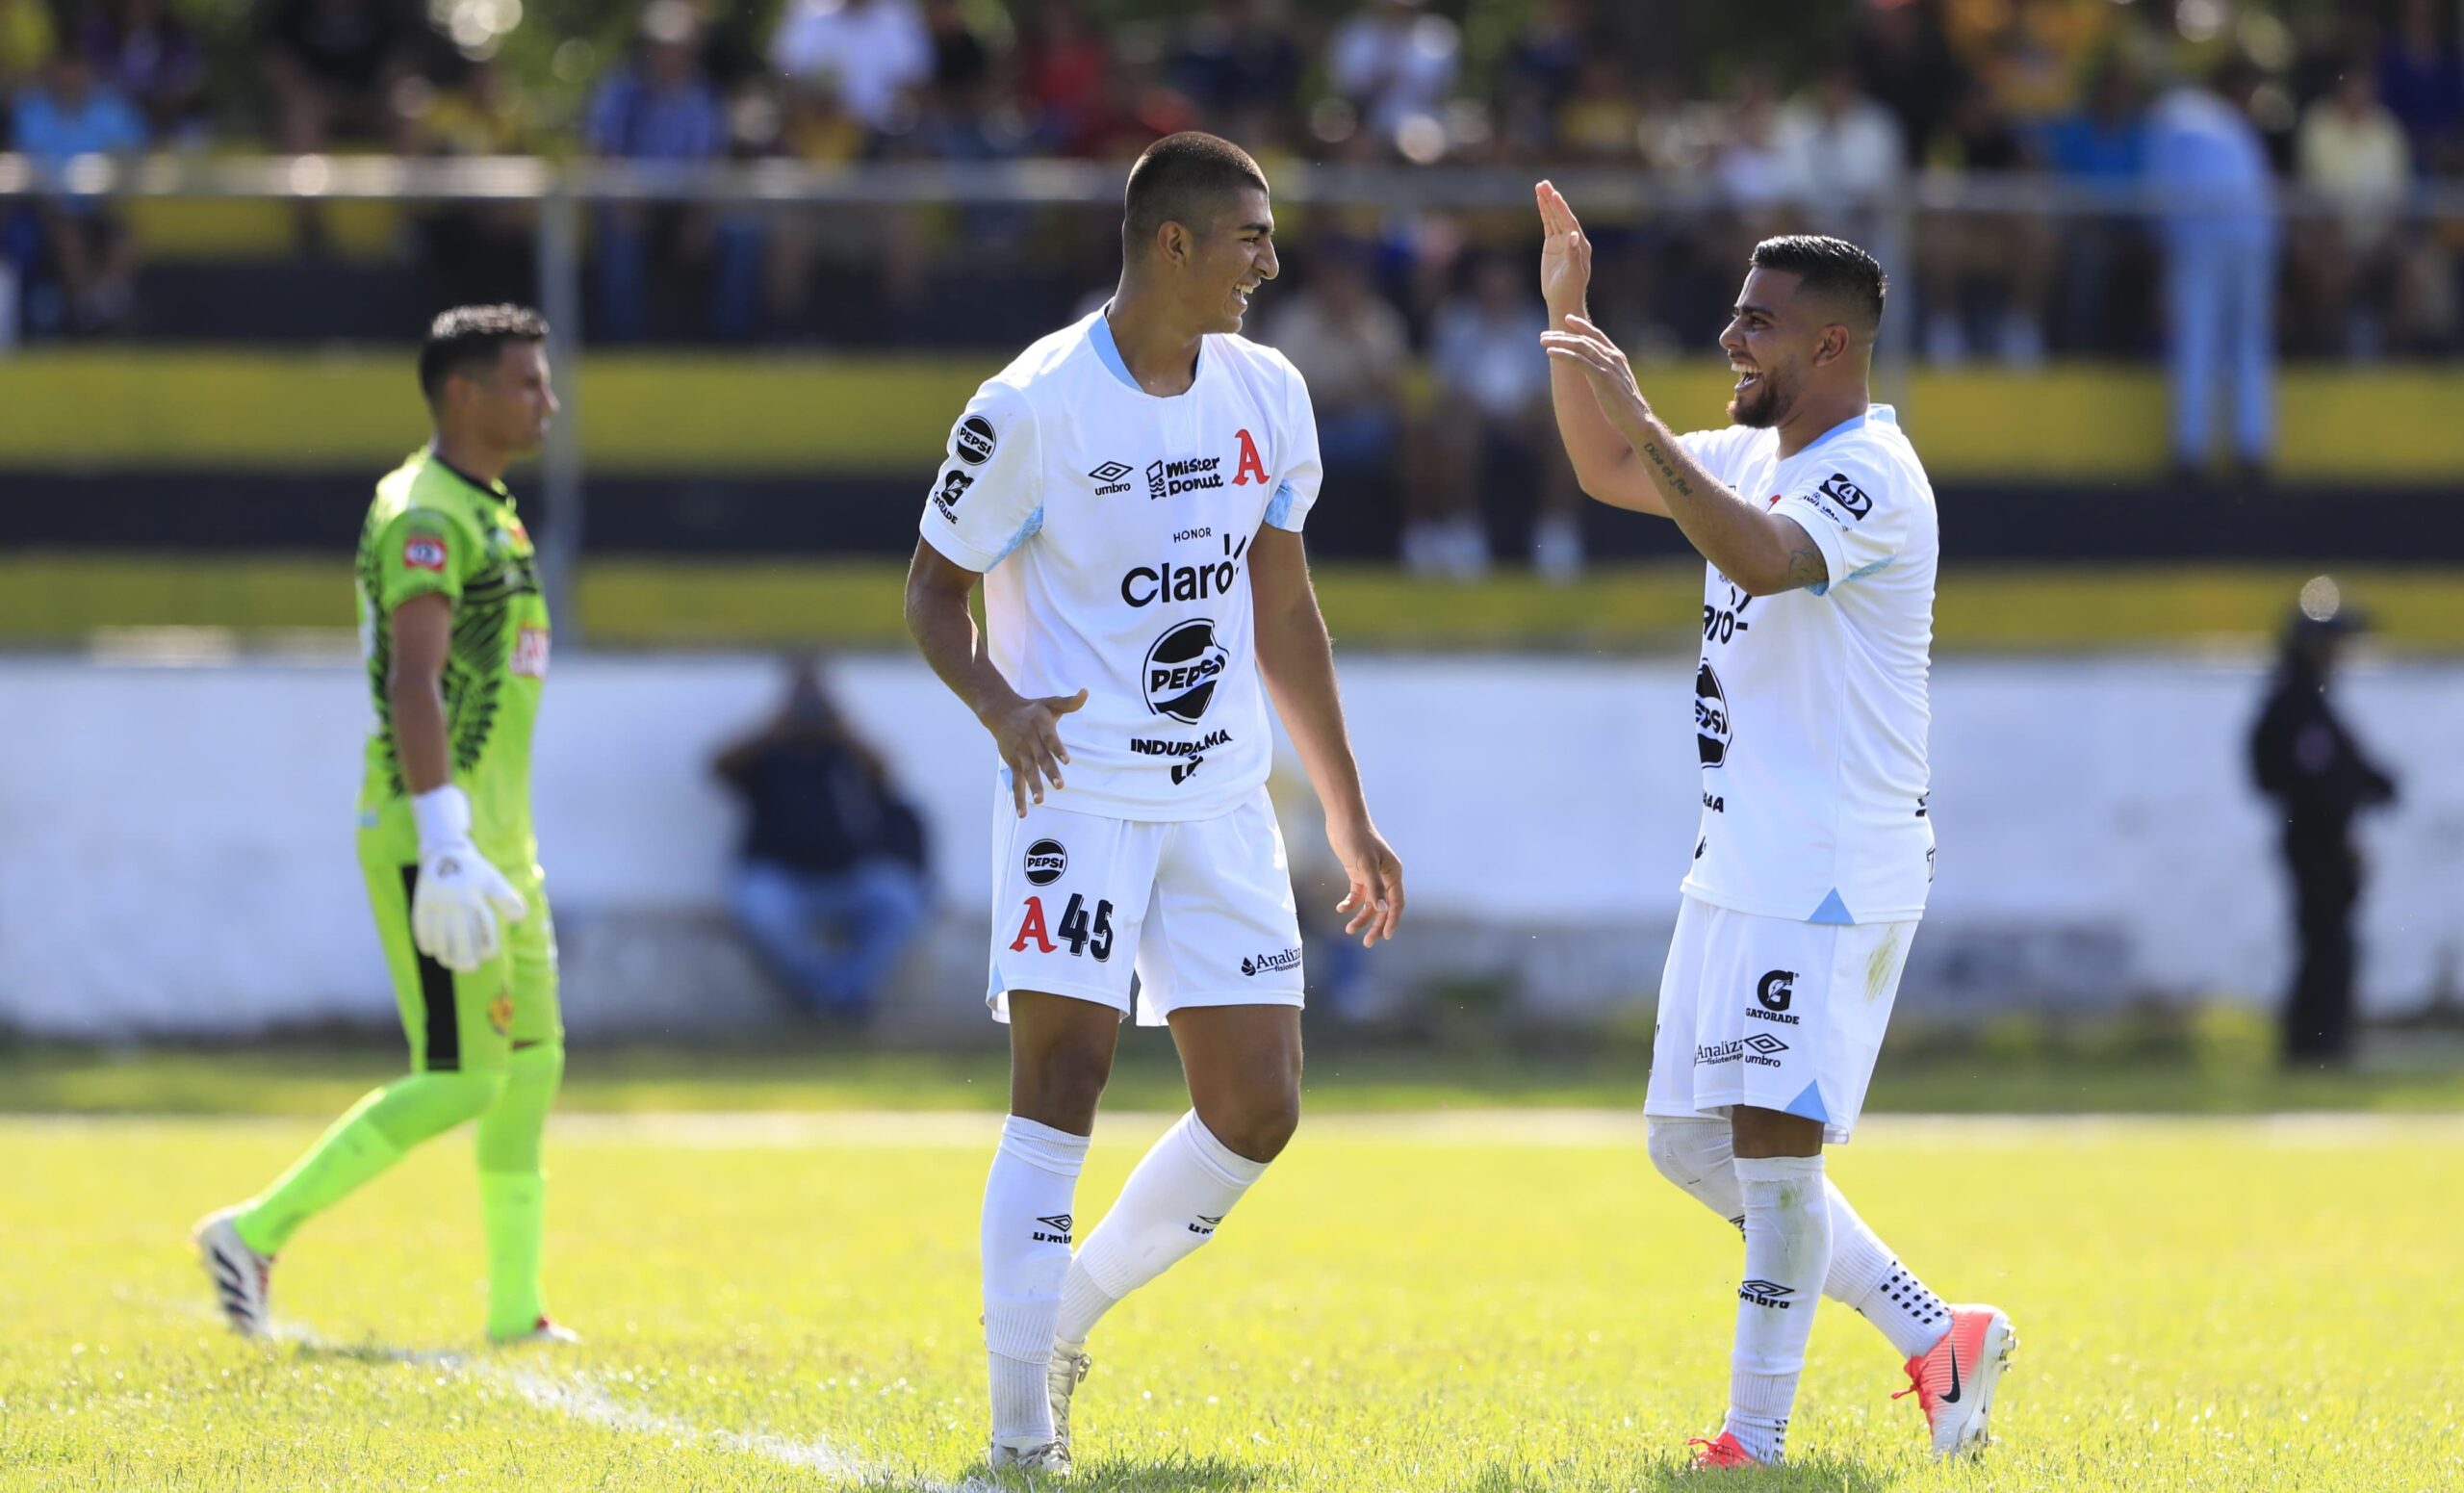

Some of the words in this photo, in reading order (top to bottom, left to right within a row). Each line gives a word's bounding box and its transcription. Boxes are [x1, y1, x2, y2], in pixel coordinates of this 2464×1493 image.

[960, 425, 992, 455] PEPSI
[1231, 428, 1270, 486] A
[1094, 482, 1131, 496] umbro
[1168, 474, 1223, 496] Donut
[1838, 485, 1858, 505] 4
[1173, 527, 1212, 544] HONOR
[1121, 560, 1234, 608] Claro
[1695, 699, 1728, 734] EPSI
[1130, 729, 1233, 757] INDUPALMA
[1027, 857, 1065, 869] PEPSI
[1009, 895, 1058, 954] A
[1058, 892, 1114, 964] 45
[1745, 1007, 1800, 1025] GATORADE
[1744, 1054, 1782, 1068] umbro
[1738, 1288, 1791, 1309] mbro
